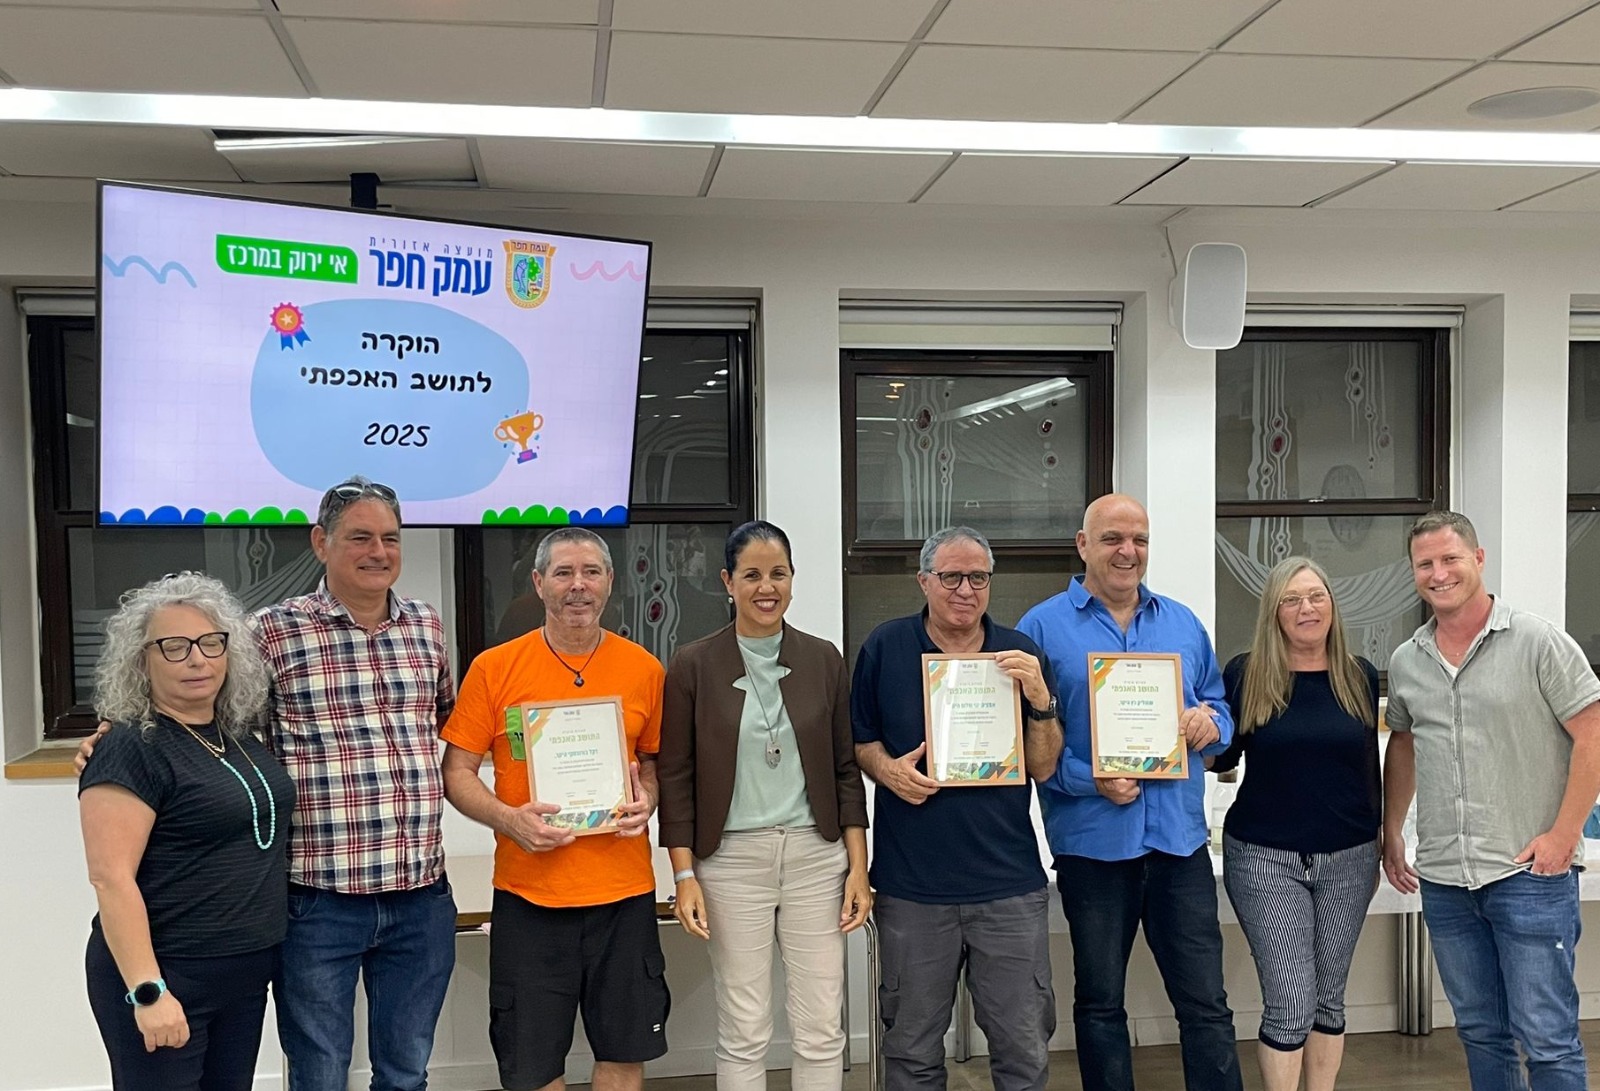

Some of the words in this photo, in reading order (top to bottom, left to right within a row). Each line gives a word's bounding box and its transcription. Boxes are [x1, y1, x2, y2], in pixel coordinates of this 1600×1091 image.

[226, 244, 282, 269] במרכז
[369, 236, 430, 253] אזורית
[443, 243, 494, 259] מועצה
[511, 241, 528, 252] חפר
[530, 243, 548, 253] עמק
[288, 249, 322, 275] ירוק
[329, 253, 347, 275] אי
[368, 249, 426, 291] חפר
[432, 255, 492, 297] עמק
[361, 331, 440, 360] הוקרה
[300, 365, 398, 389] האכפתי
[409, 371, 492, 394] לתושב
[363, 422, 431, 448] 2025
